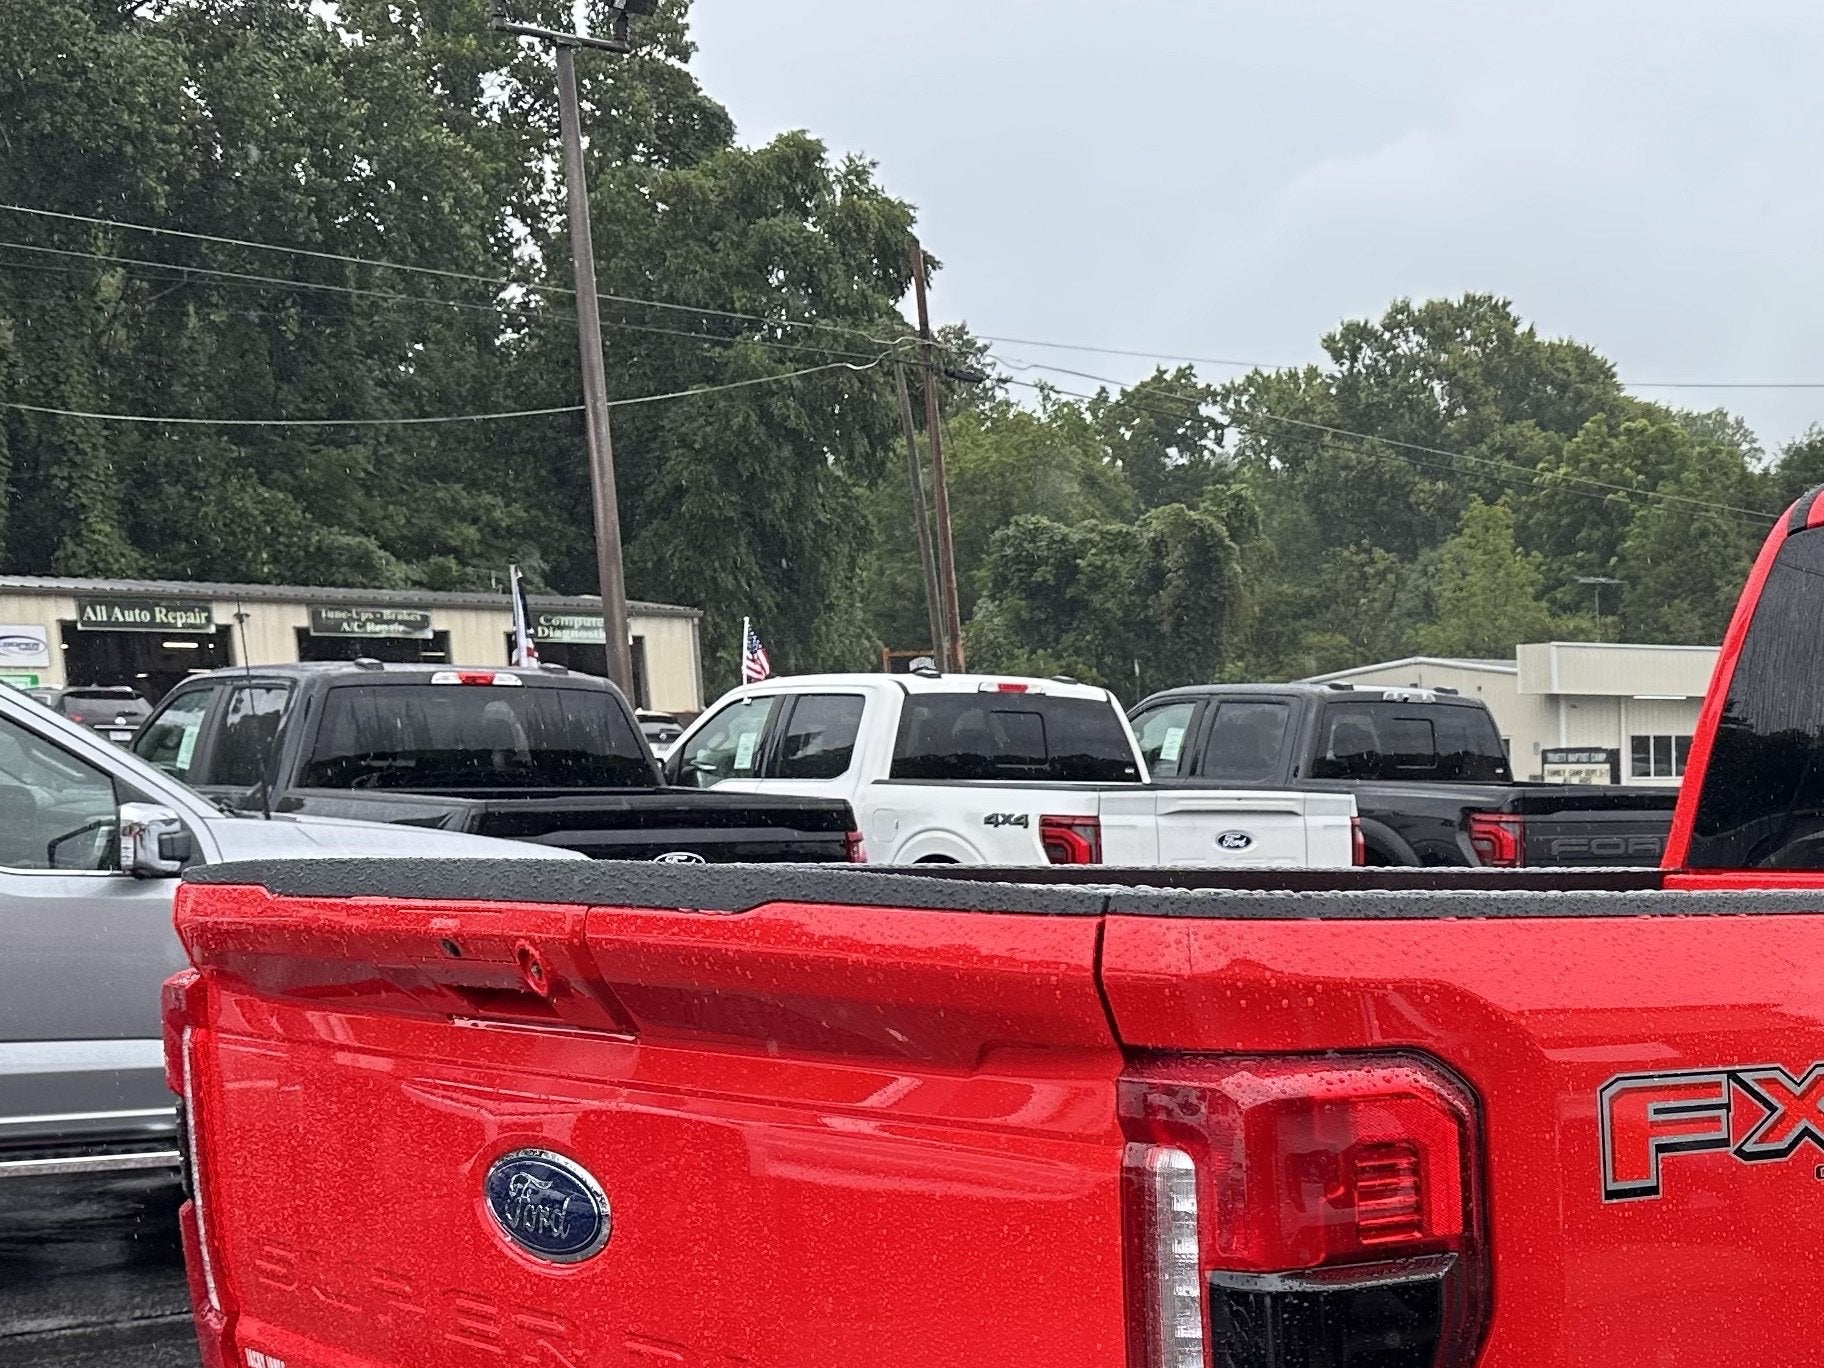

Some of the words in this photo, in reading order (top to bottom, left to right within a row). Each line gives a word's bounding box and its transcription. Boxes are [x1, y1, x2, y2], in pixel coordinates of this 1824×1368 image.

[82, 605, 107, 621] All
[111, 606, 150, 622] Auto
[154, 607, 209, 627] Repair
[539, 615, 605, 629] Compute
[1551, 837, 1668, 856] FOR
